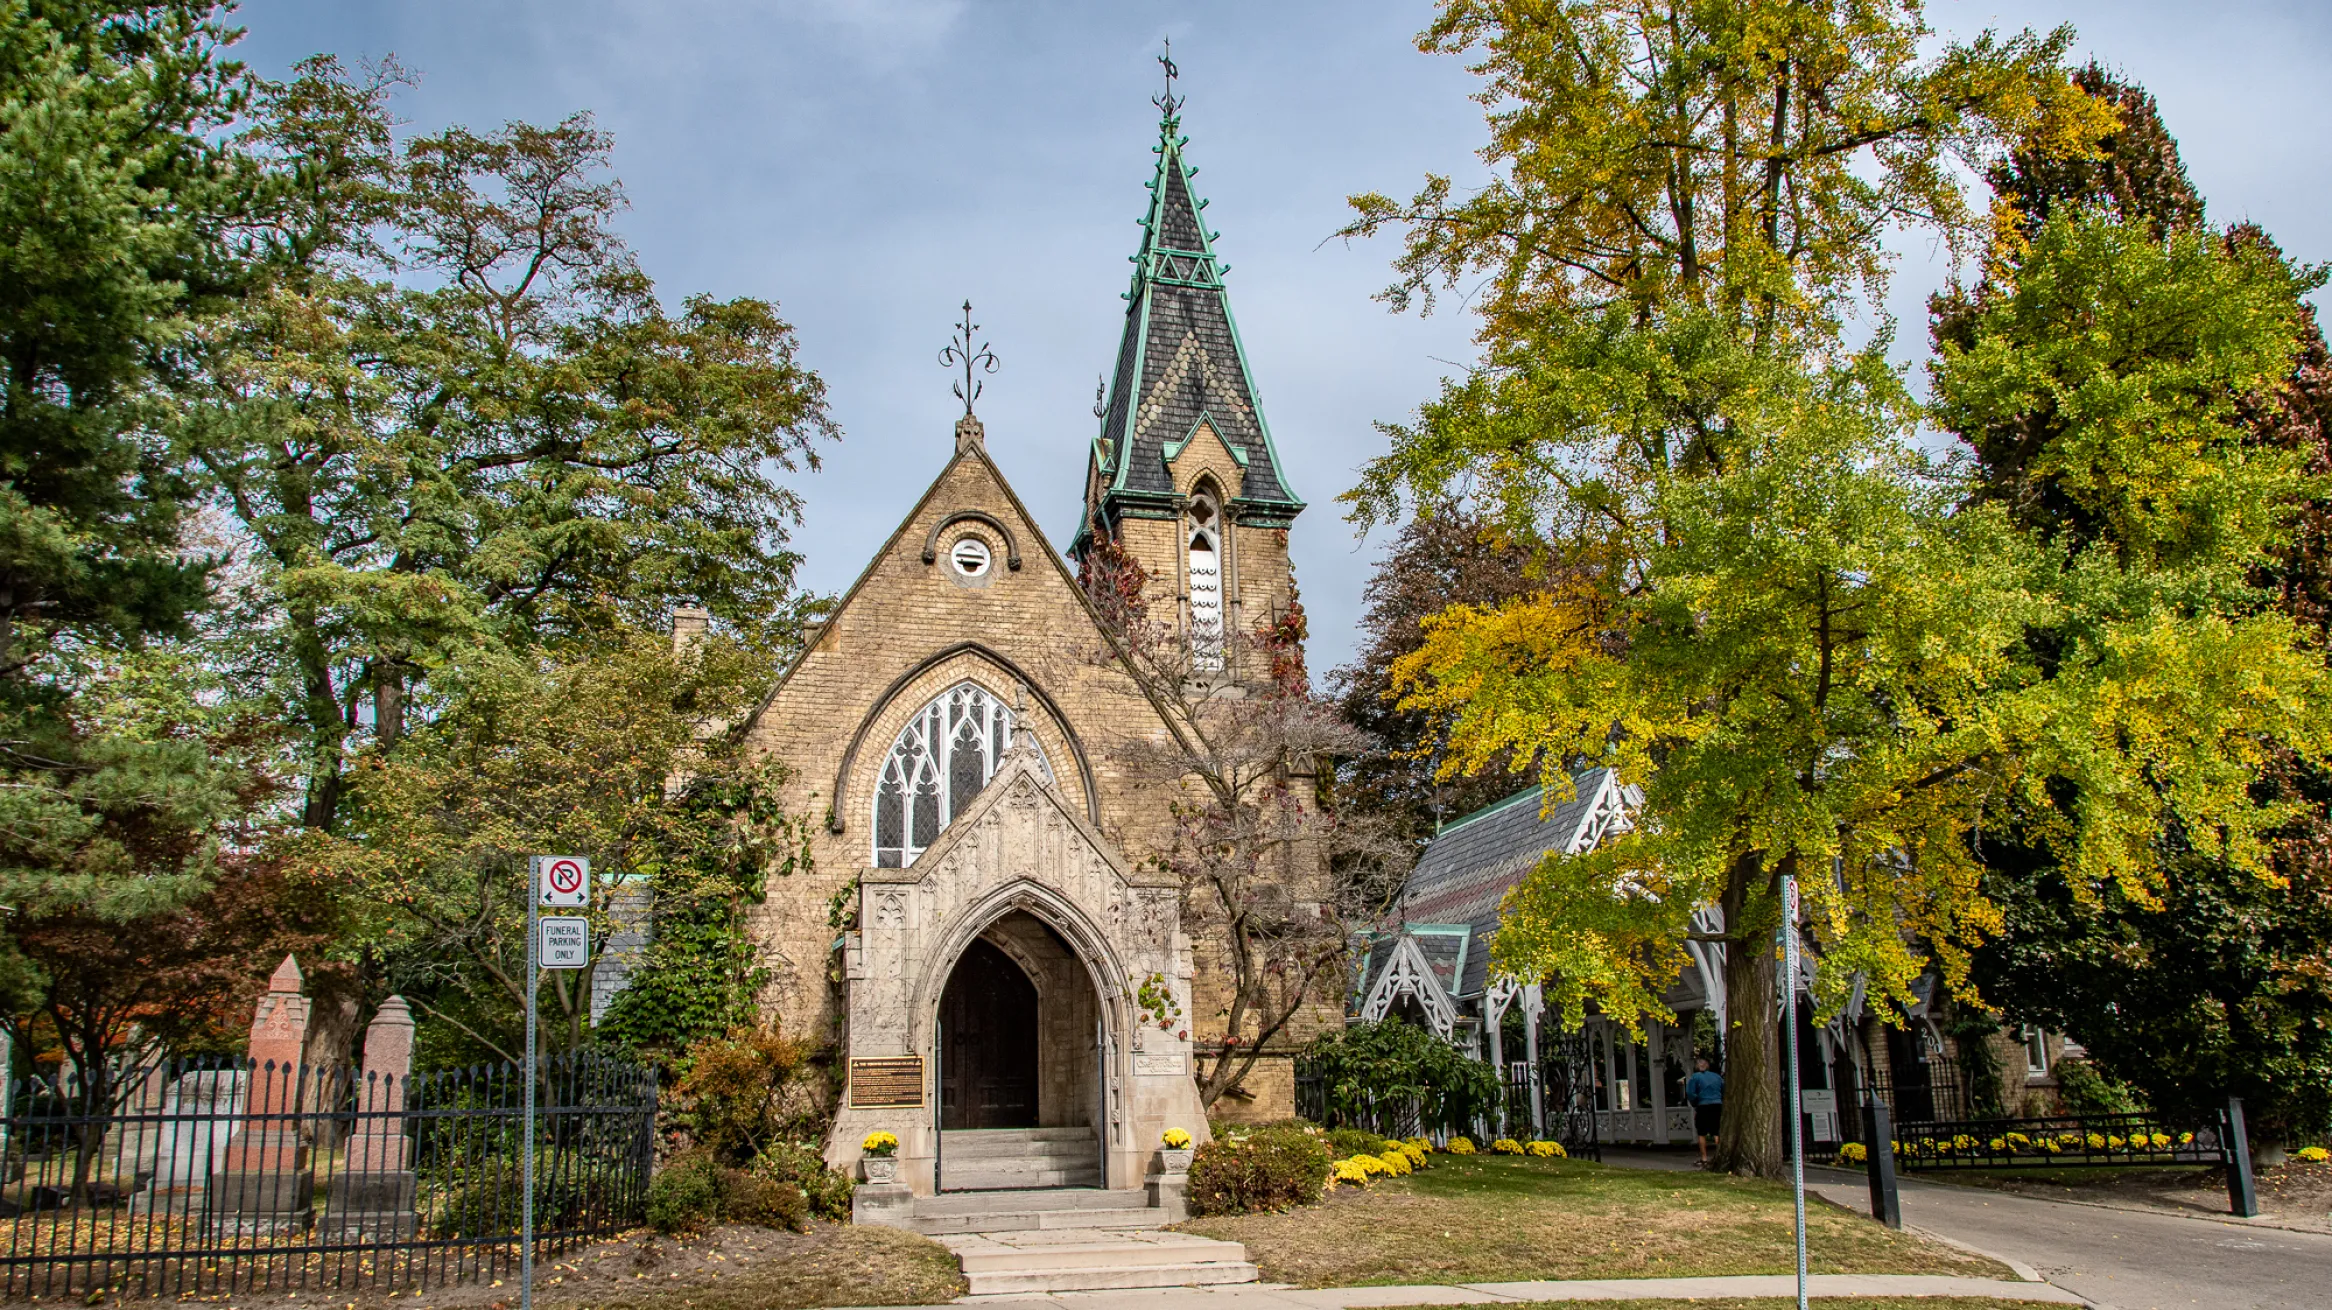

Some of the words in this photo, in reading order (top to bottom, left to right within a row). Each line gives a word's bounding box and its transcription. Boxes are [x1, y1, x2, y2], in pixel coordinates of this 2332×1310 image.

[546, 925, 581, 935] FUNERAL
[548, 937, 582, 946] PARKING
[554, 950, 575, 959] ONLY
[1920, 1027, 1941, 1054] 200
